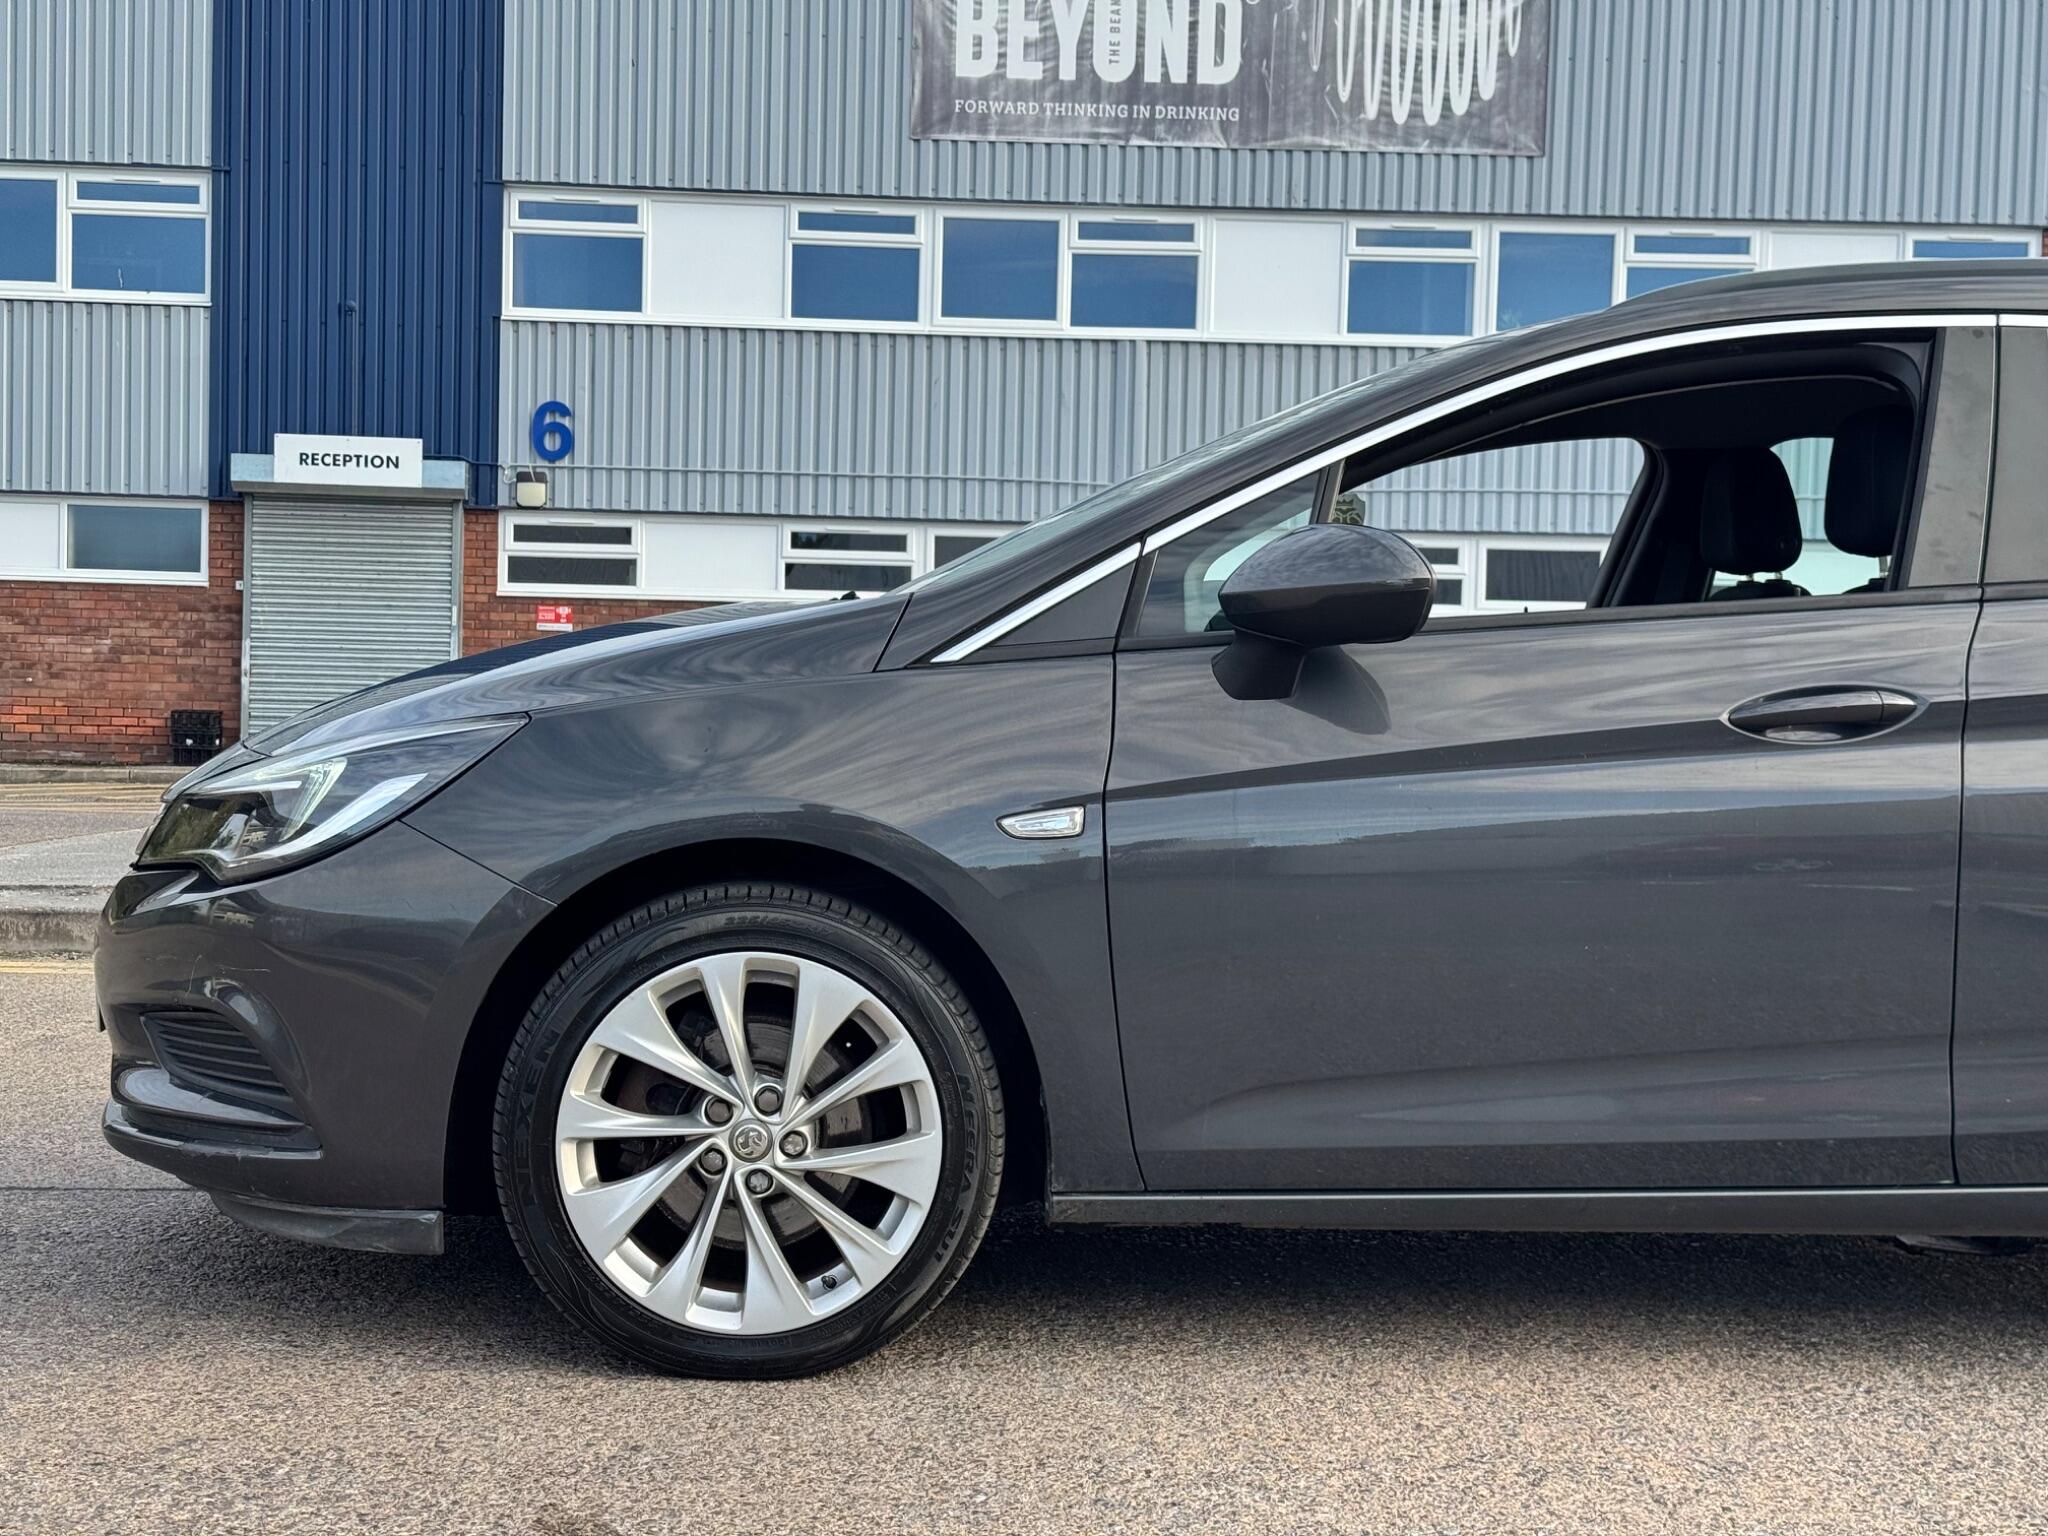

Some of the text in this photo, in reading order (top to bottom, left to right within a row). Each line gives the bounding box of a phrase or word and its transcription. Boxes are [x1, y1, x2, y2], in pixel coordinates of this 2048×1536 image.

[955, 0, 1243, 85] BEYOND
[1108, 0, 1121, 65] THE BEAN
[954, 99, 1240, 121] FORWARD THINKING IN DRINKING
[299, 452, 400, 469] RECEPTION
[532, 400, 575, 462] 6
[514, 1029, 562, 1204] NEXEN
